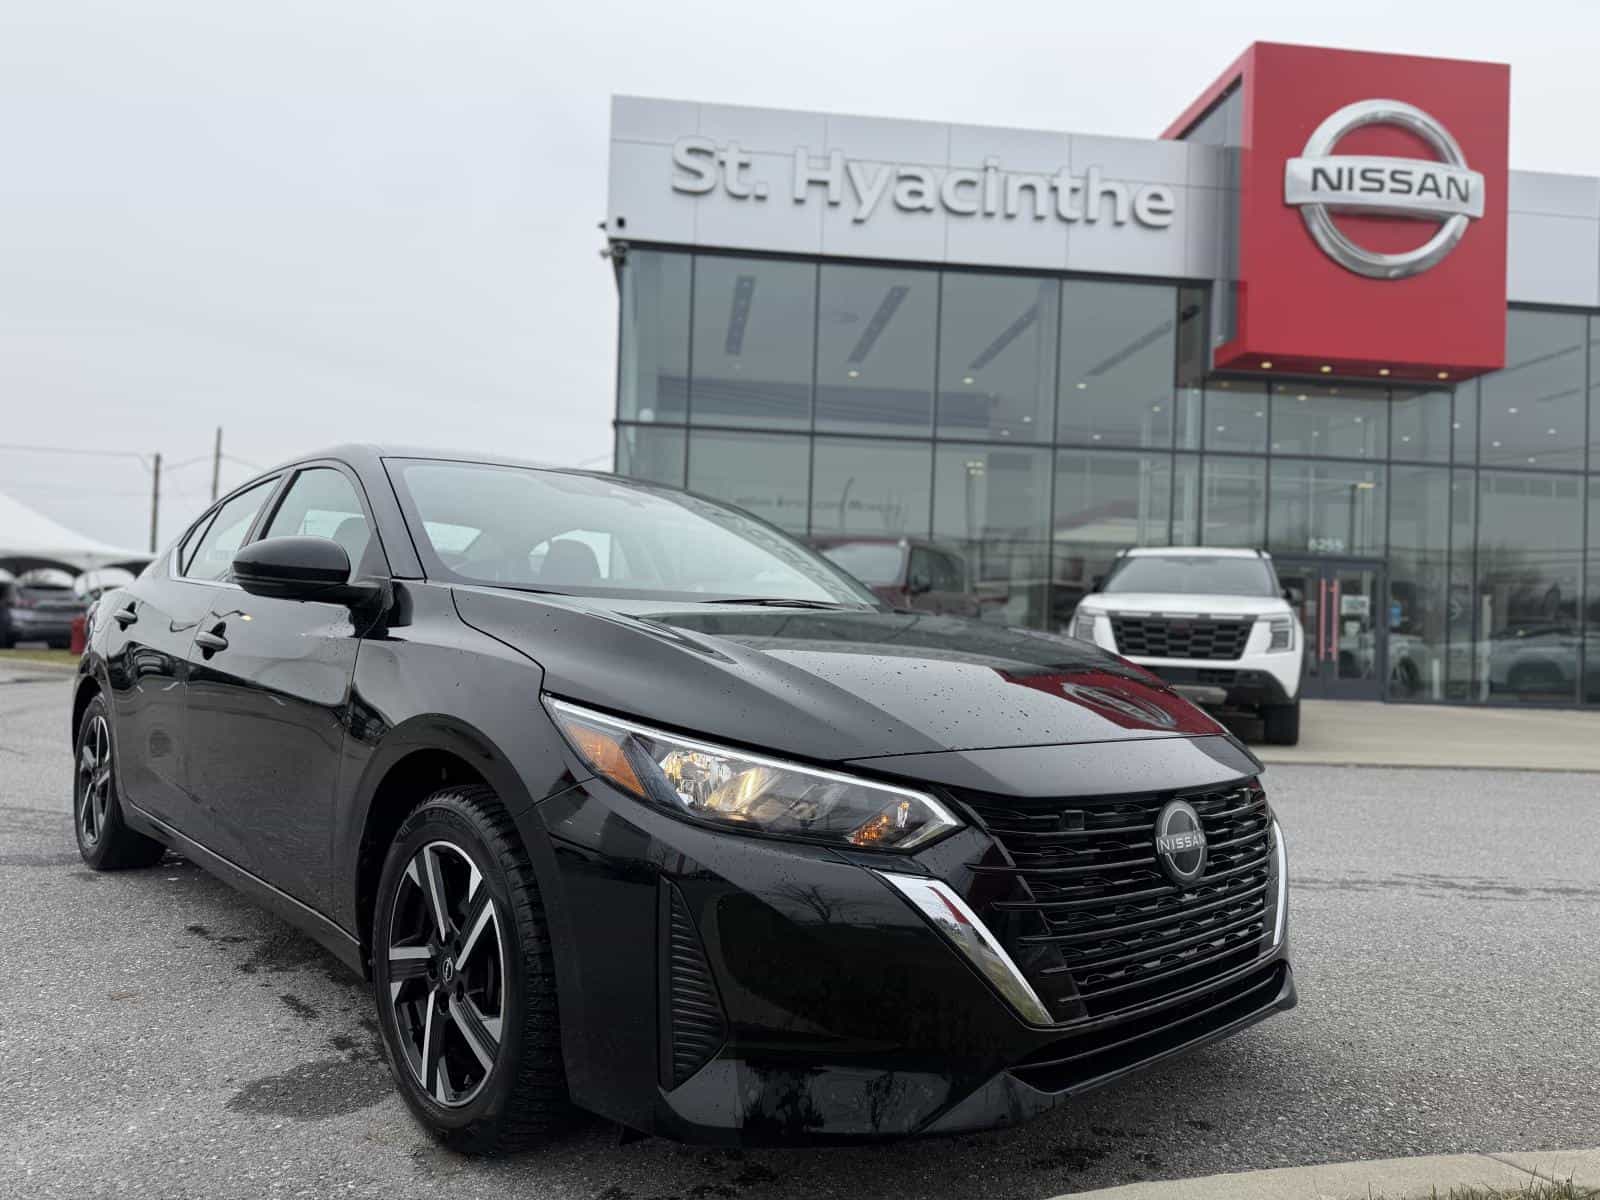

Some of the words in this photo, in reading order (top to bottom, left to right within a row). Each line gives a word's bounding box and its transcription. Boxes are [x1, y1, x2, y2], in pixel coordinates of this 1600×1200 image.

[671, 136, 768, 202] St.
[795, 146, 1175, 229] Hyacinthe
[1311, 167, 1470, 203] NISSAN
[1159, 833, 1206, 851] NISSAN
